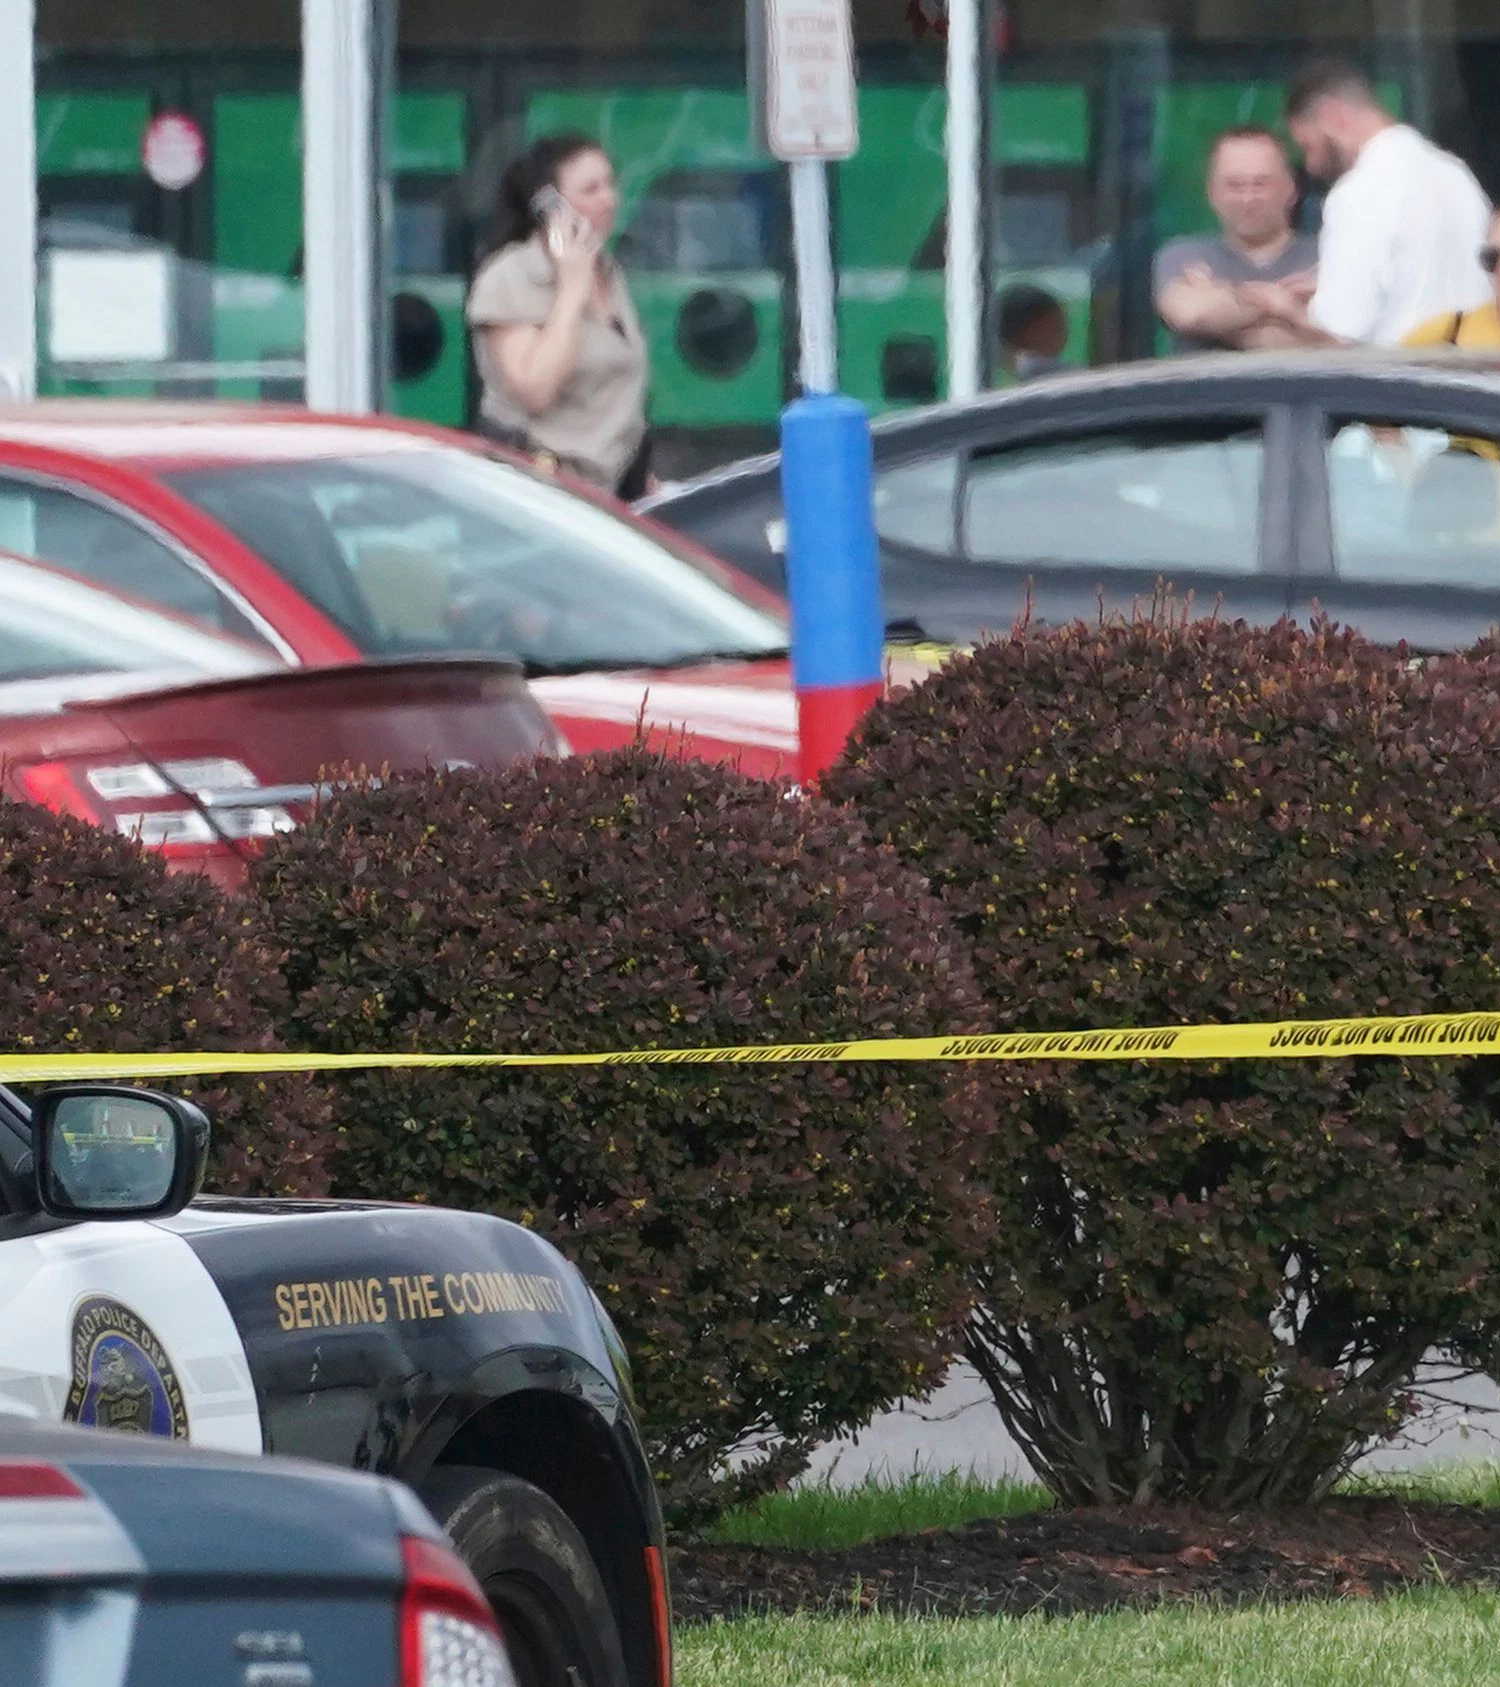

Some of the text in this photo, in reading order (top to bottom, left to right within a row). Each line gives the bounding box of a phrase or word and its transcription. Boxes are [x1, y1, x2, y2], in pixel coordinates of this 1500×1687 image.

[275, 1272, 573, 1331] SERVING THE COMMUNITY
[70, 1315, 96, 1406] BUFFALO
[91, 1306, 139, 1338] POLICE
